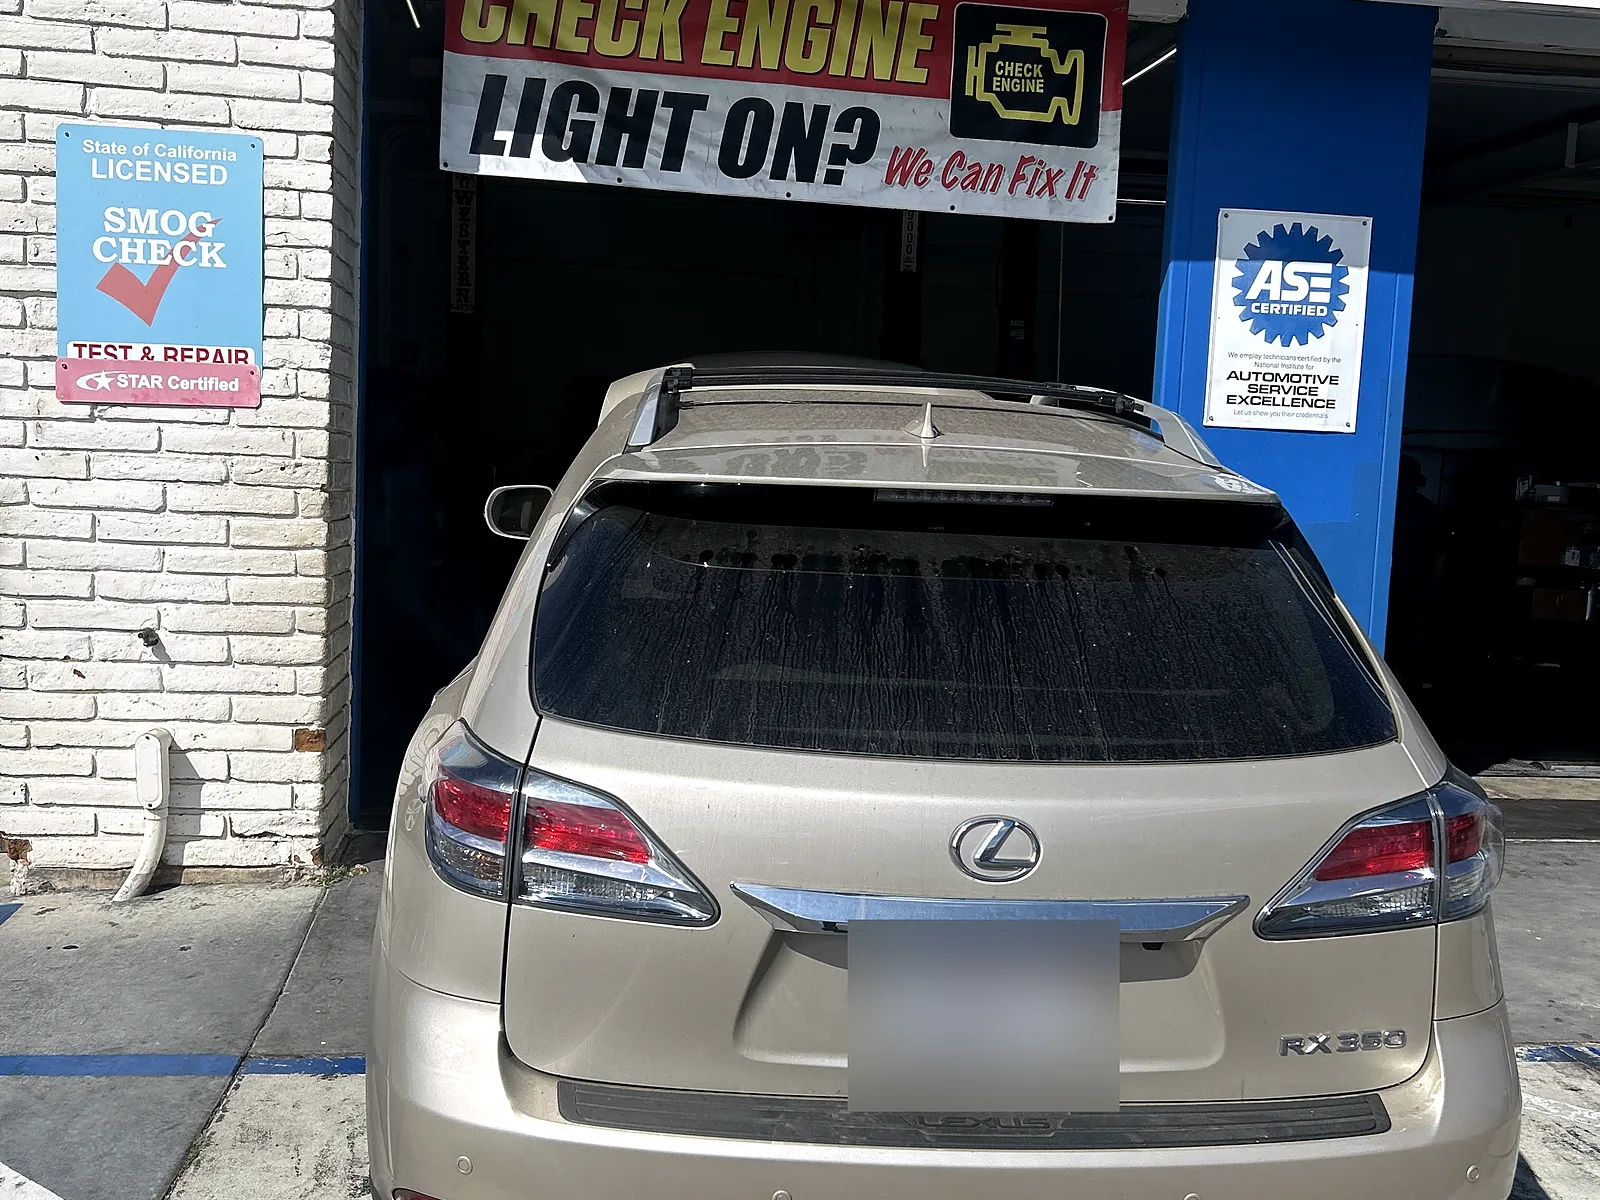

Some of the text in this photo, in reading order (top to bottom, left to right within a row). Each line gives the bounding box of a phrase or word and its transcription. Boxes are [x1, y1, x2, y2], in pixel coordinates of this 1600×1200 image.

[460, 0, 940, 84] CHECK ENGINE
[994, 60, 1044, 79] CHECK
[992, 77, 1045, 94] ENGINE
[469, 73, 881, 186] LIGHT ON?
[83, 139, 237, 162] State of California
[91, 157, 228, 186] LICENSED
[884, 145, 1098, 201] We Can Fix It
[103, 206, 216, 238] SMOG
[92, 236, 227, 268] CHECK
[1245, 259, 1333, 304] ASE
[1251, 302, 1328, 317] CERTIFIED
[73, 343, 249, 364] TEST & REPAIR
[1240, 353, 1262, 361] employ
[1323, 356, 1331, 364] by
[1254, 361, 1280, 369] National
[116, 373, 239, 392] STAR Certified
[1226, 370, 1339, 386] AUTOMOTIVE
[1247, 383, 1319, 396] SERVICE
[1226, 394, 1336, 409] EXCELLENCE
[1252, 409, 1269, 417] show
[1279, 1028, 1407, 1056] RX 350
[917, 1114, 1051, 1130] LEXUS
